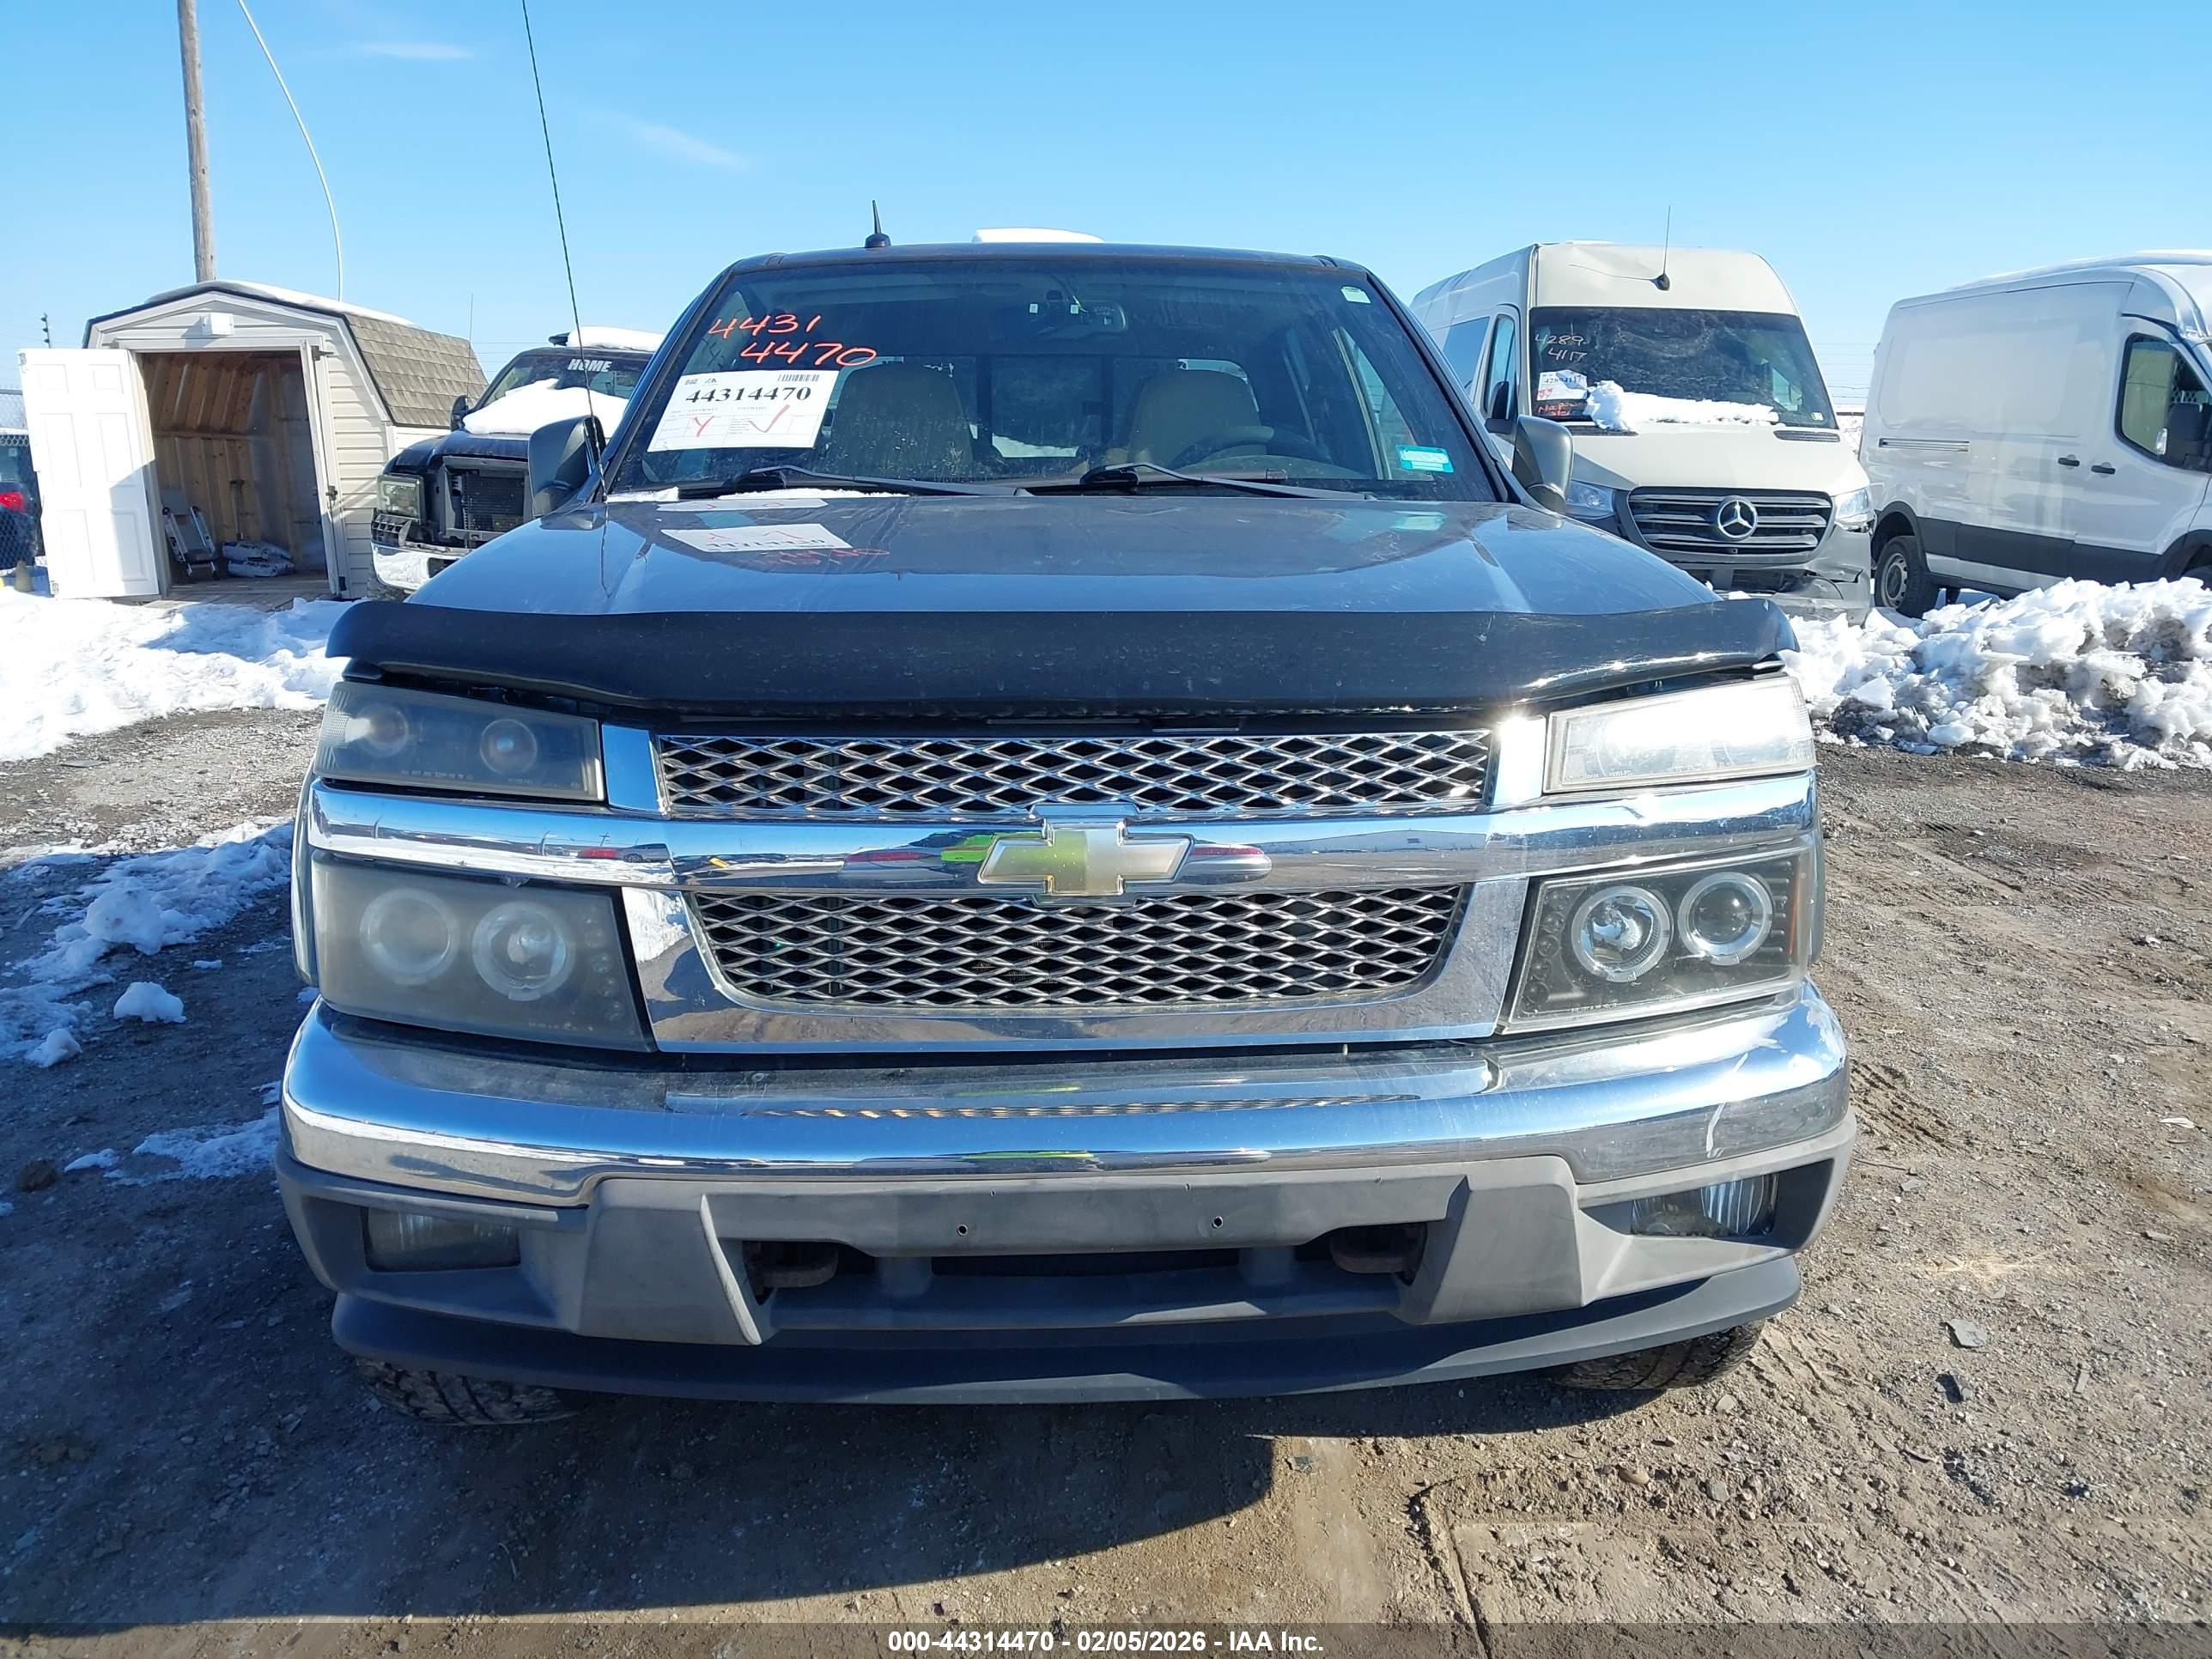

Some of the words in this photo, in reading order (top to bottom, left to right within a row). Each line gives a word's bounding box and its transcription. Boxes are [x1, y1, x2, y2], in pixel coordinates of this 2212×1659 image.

[708, 314, 822, 338] 4431
[1535, 334, 1584, 346] 4289
[740, 341, 878, 367] 4470
[1547, 348, 1588, 362] 4117
[567, 358, 613, 373] HOME
[684, 386, 811, 404] 44314470
